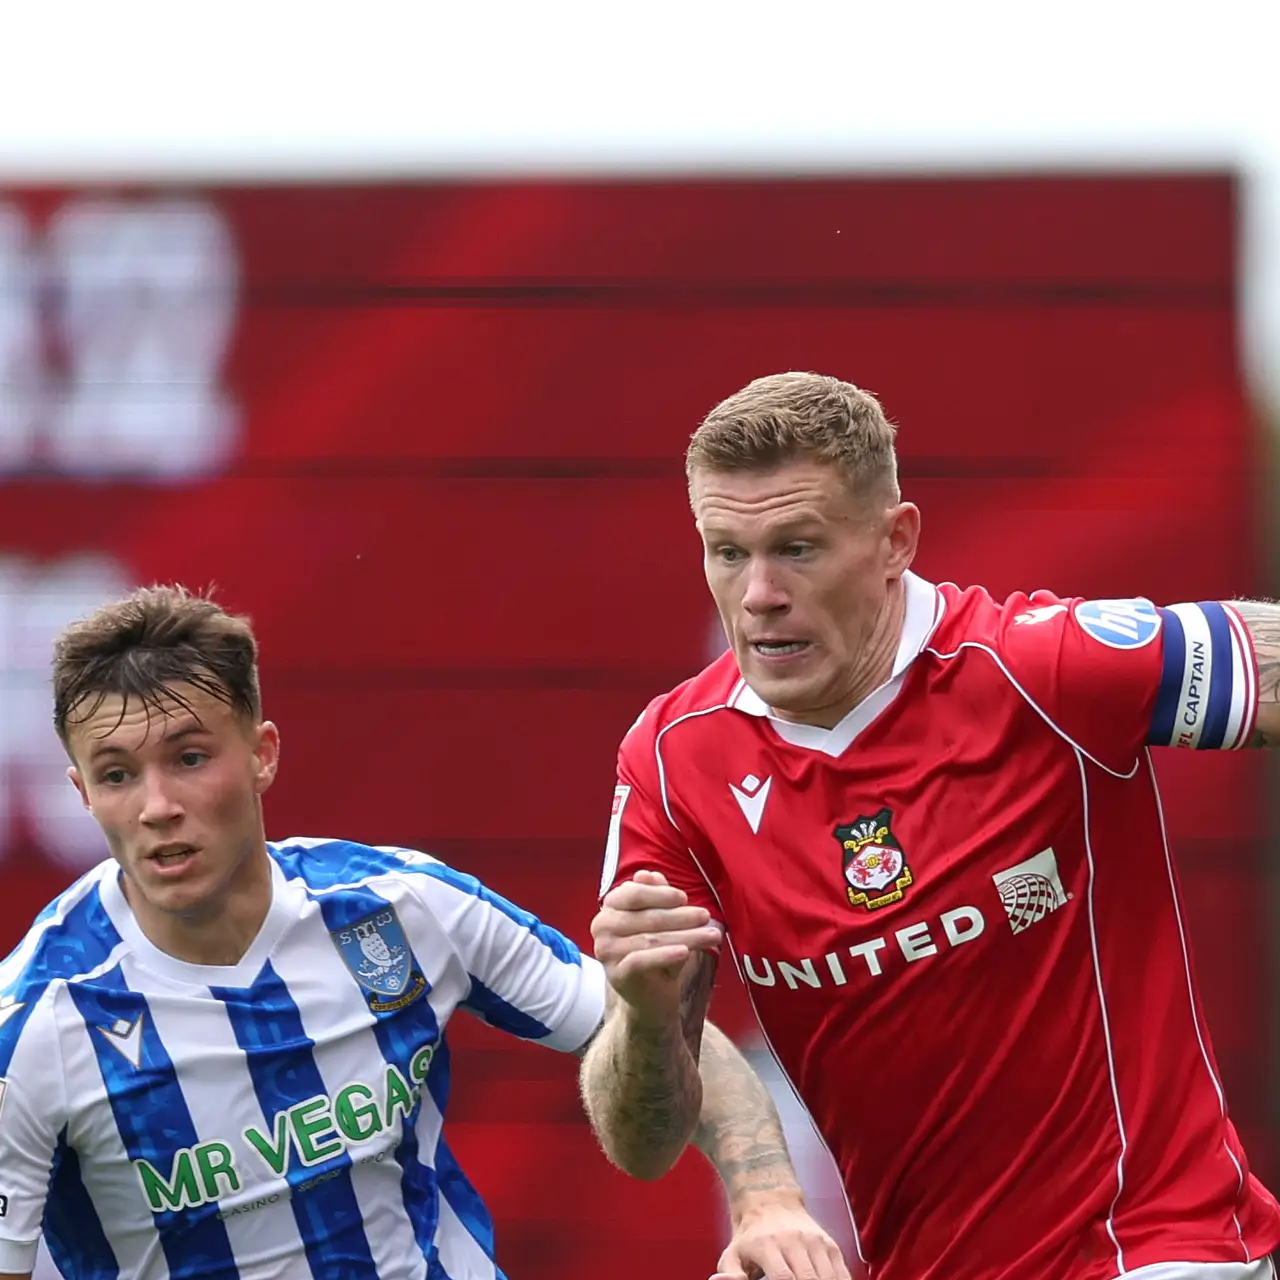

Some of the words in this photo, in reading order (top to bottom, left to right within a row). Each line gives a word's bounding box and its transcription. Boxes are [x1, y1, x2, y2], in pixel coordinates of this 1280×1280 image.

[1184, 641, 1205, 727] CAPTAIN
[743, 905, 986, 990] UNITED
[136, 1143, 240, 1212] MR
[217, 1193, 280, 1220] CASINO
